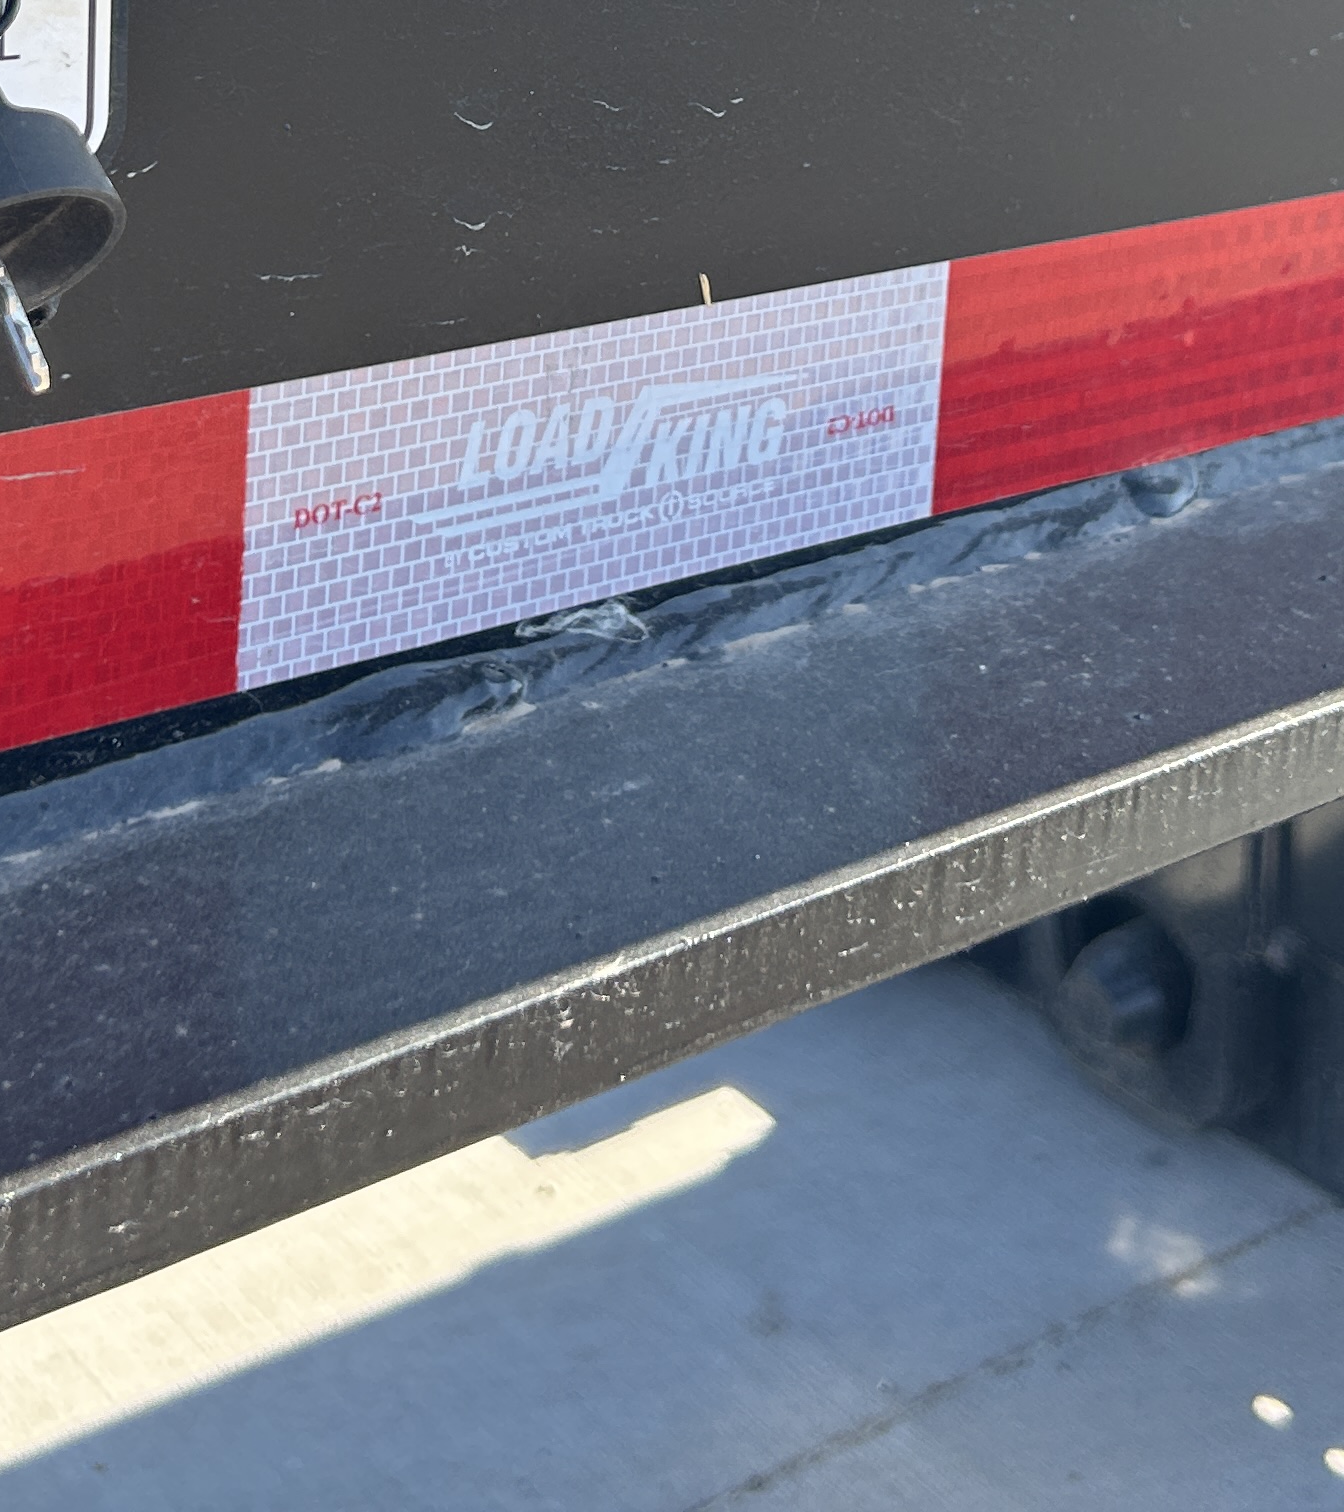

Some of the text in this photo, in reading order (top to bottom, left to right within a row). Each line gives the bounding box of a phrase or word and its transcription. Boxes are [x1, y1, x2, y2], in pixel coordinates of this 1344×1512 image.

[457, 395, 787, 491] LOAD KING
[293, 491, 383, 530] DOT-C2
